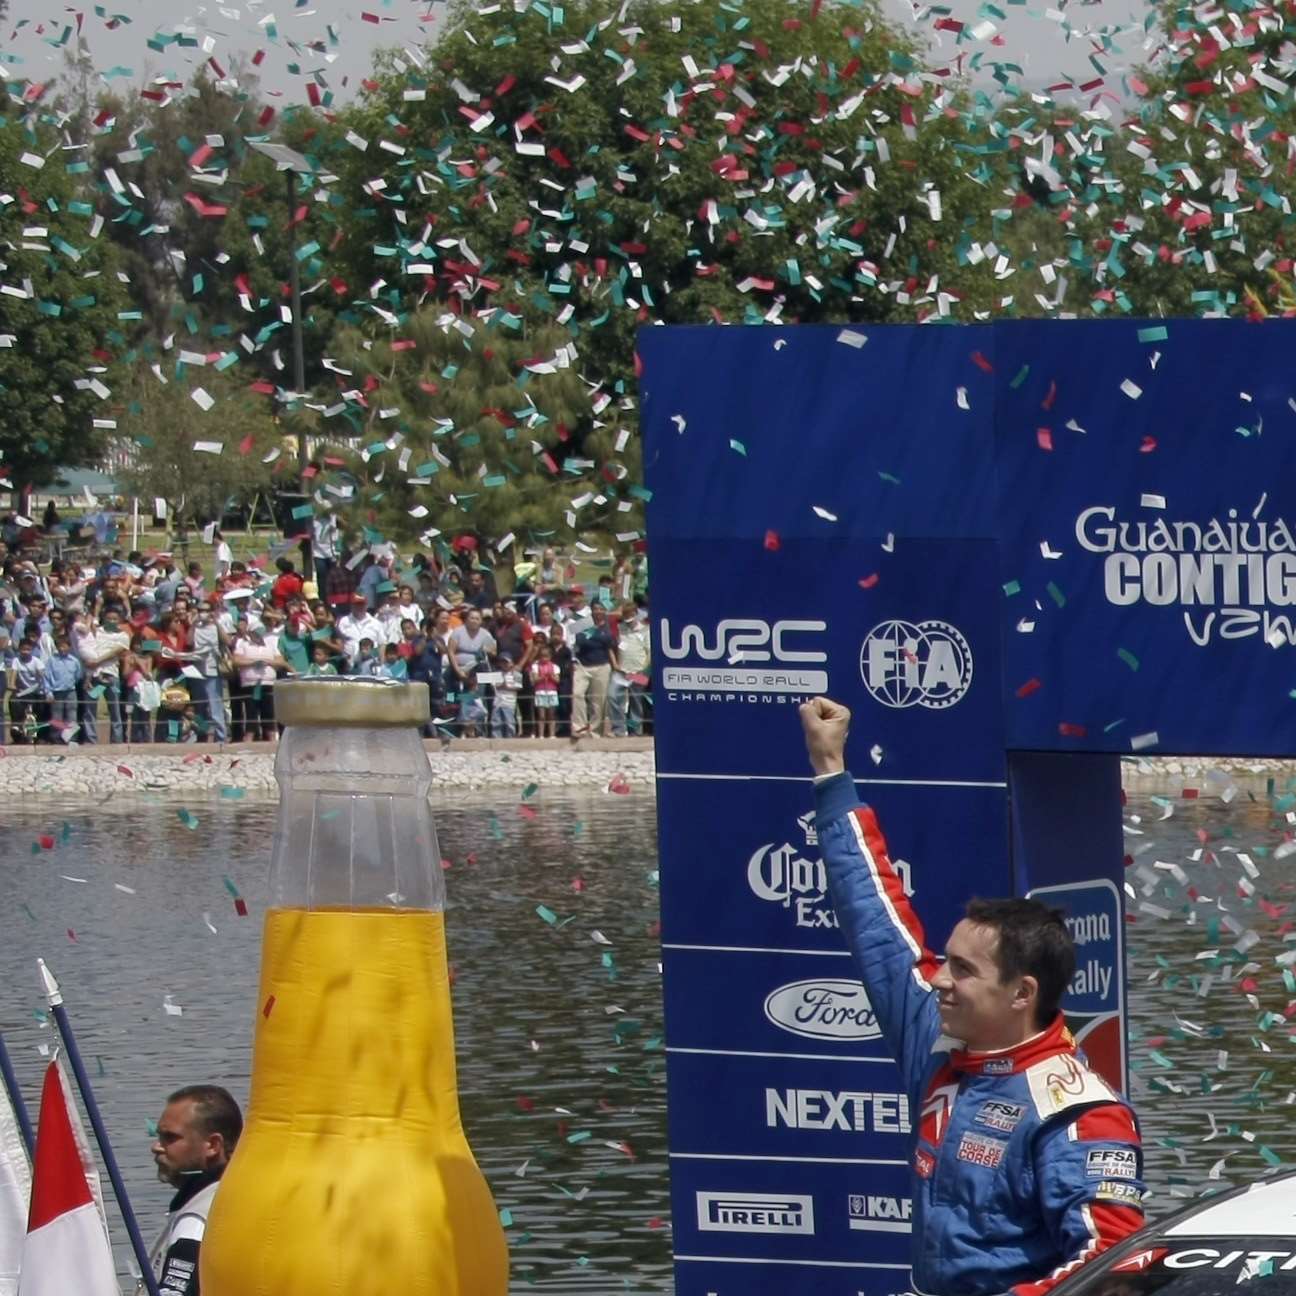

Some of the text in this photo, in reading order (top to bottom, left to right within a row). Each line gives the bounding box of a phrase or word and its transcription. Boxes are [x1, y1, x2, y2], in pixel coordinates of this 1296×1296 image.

[661, 617, 828, 663] WRC
[867, 638, 962, 689] FIA
[668, 674, 692, 684] FIA
[697, 674, 758, 686] WORLD
[766, 1087, 912, 1134] NEXTEL
[982, 1102, 1022, 1118] FFSA
[958, 1150, 1000, 1168] CORSE
[1089, 1150, 1136, 1164] FFSA
[708, 1199, 804, 1227] PIRELLI
